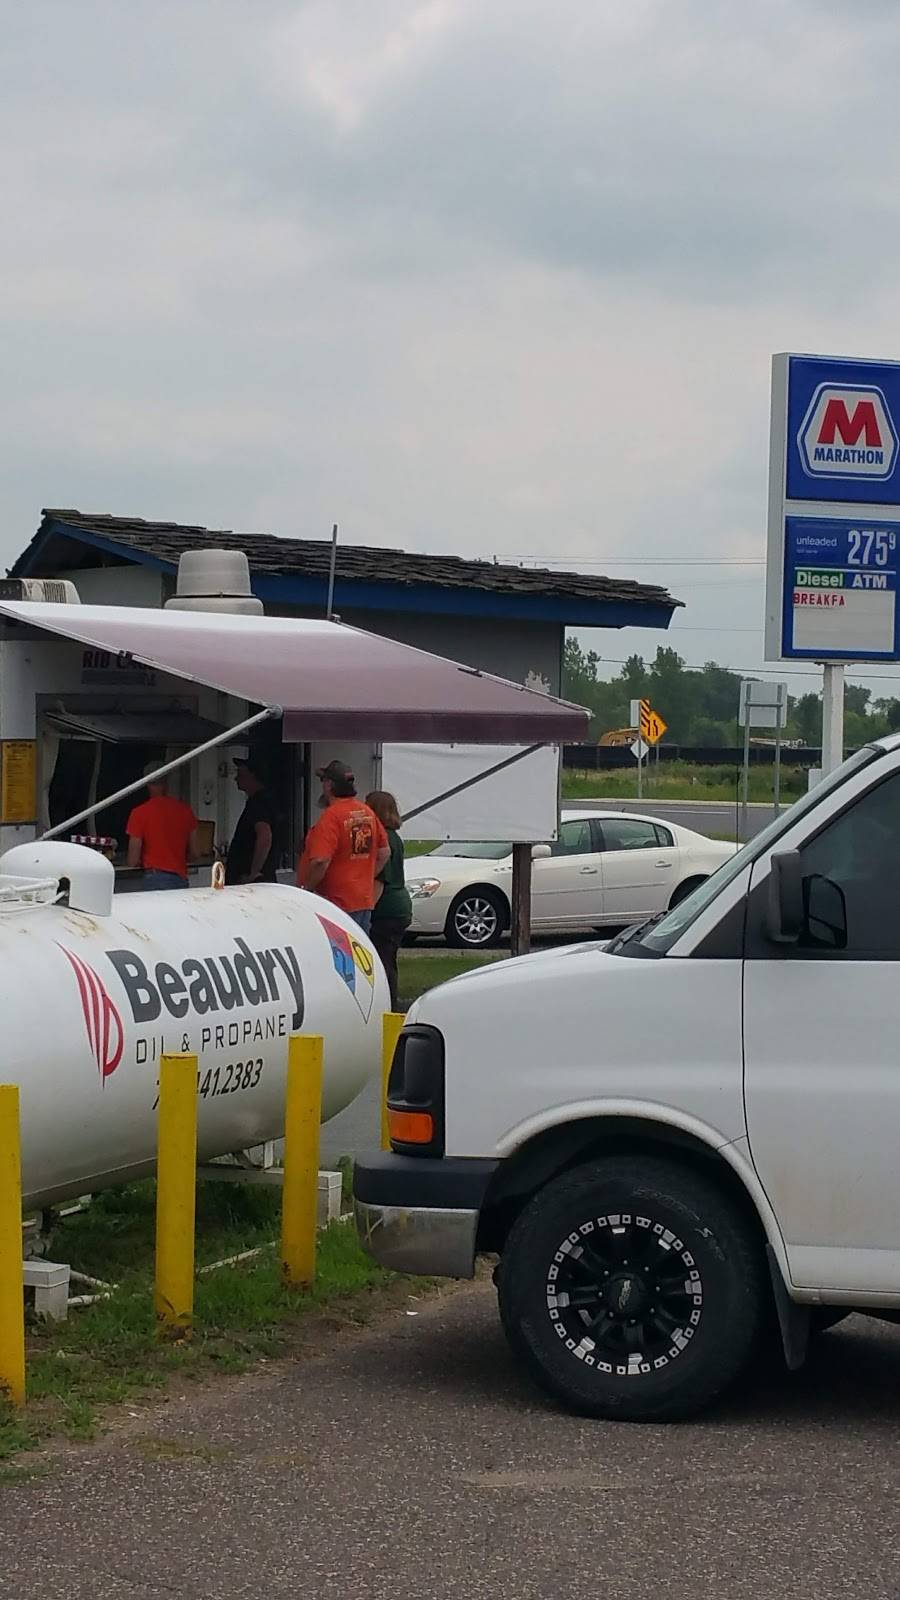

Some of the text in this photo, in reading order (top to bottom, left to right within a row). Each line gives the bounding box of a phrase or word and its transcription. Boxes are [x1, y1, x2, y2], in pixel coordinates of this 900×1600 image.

[817, 400, 882, 447] M
[813, 447, 884, 465] MARATHON
[796, 536, 838, 547] unleaded
[796, 571, 887, 588] Diesel ATM
[793, 593, 845, 606] BREAKFA
[105, 936, 305, 1030] Beaudry
[181, 1033, 190, 1052] &
[202, 1014, 286, 1052] PROPANE
